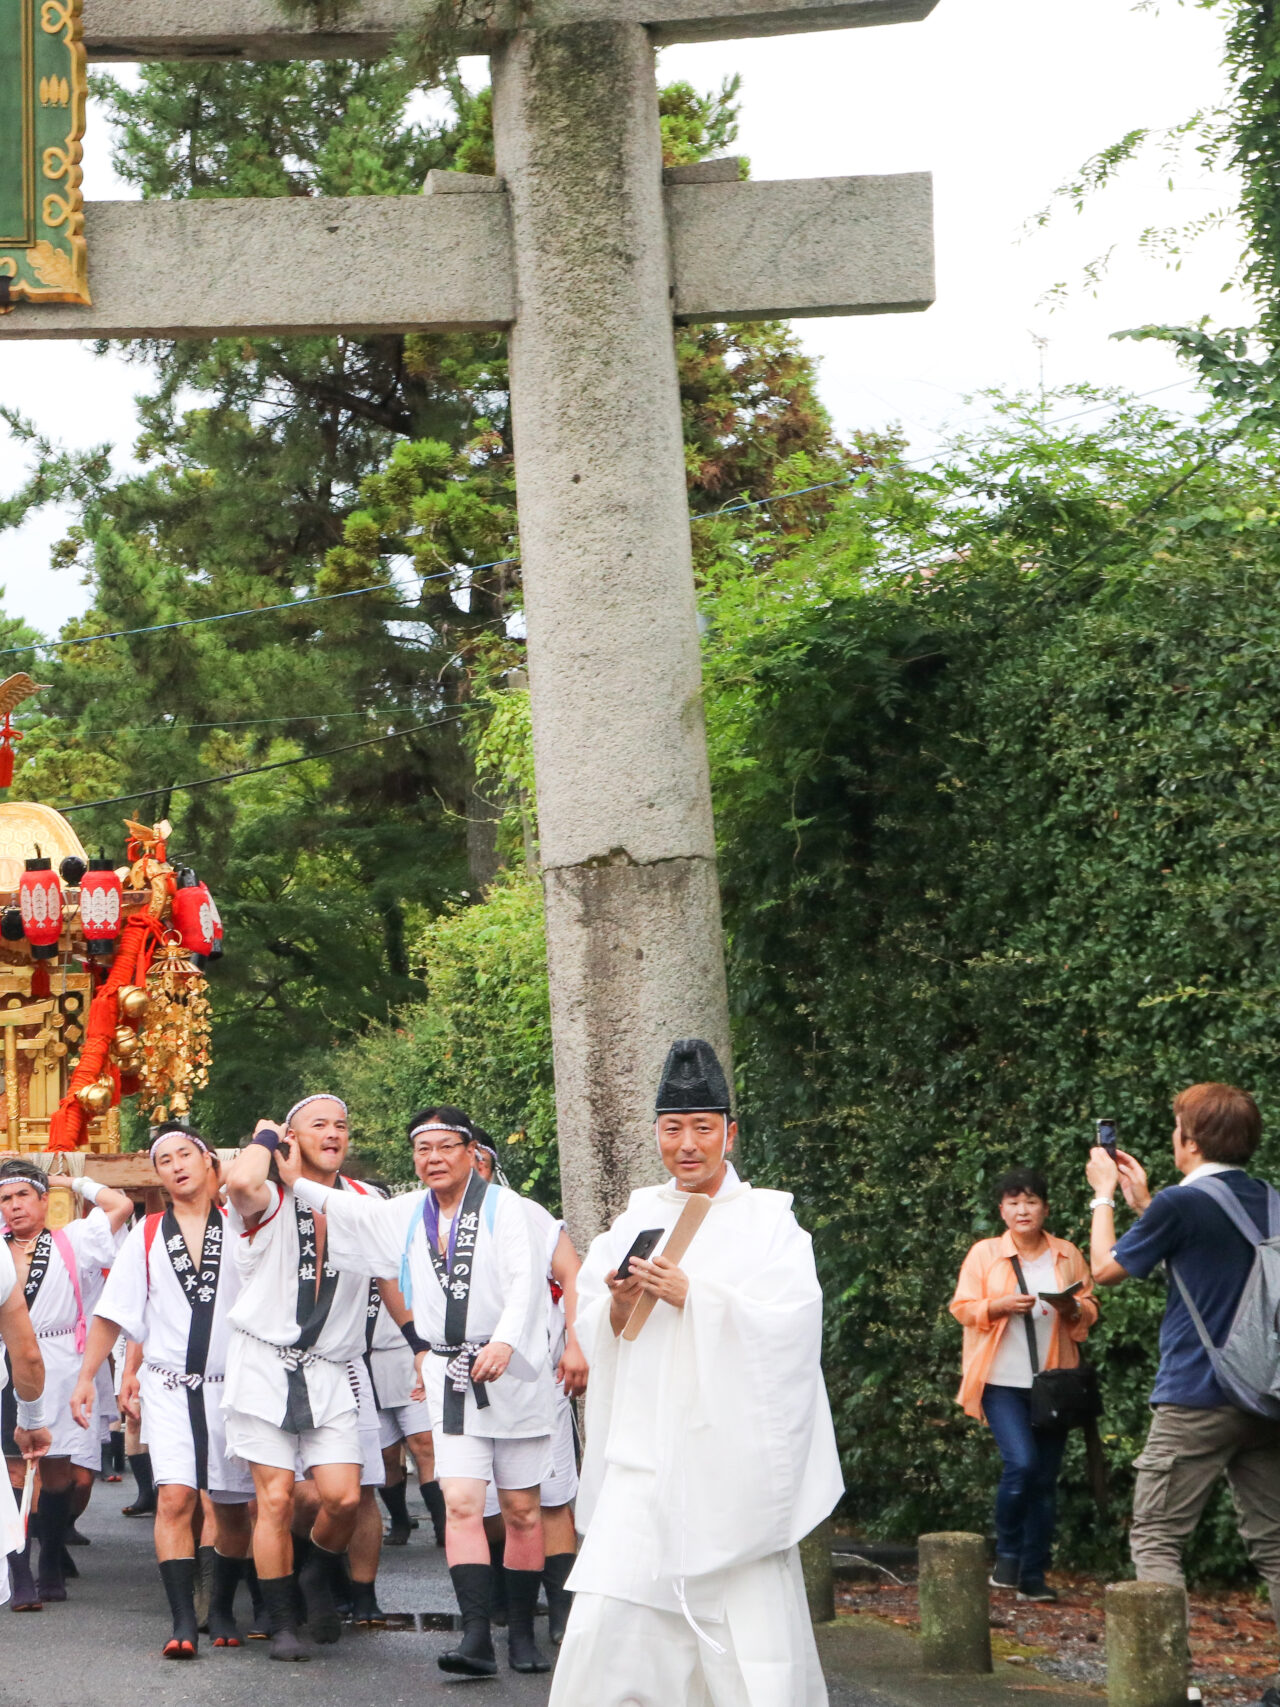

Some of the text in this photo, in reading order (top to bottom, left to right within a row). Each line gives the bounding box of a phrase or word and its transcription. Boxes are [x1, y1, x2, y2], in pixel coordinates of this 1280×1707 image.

[166, 1234, 198, 1304] 建部大
[197, 1225, 222, 1302] 近江一の宮
[450, 1211, 478, 1300] 近江一の宮
